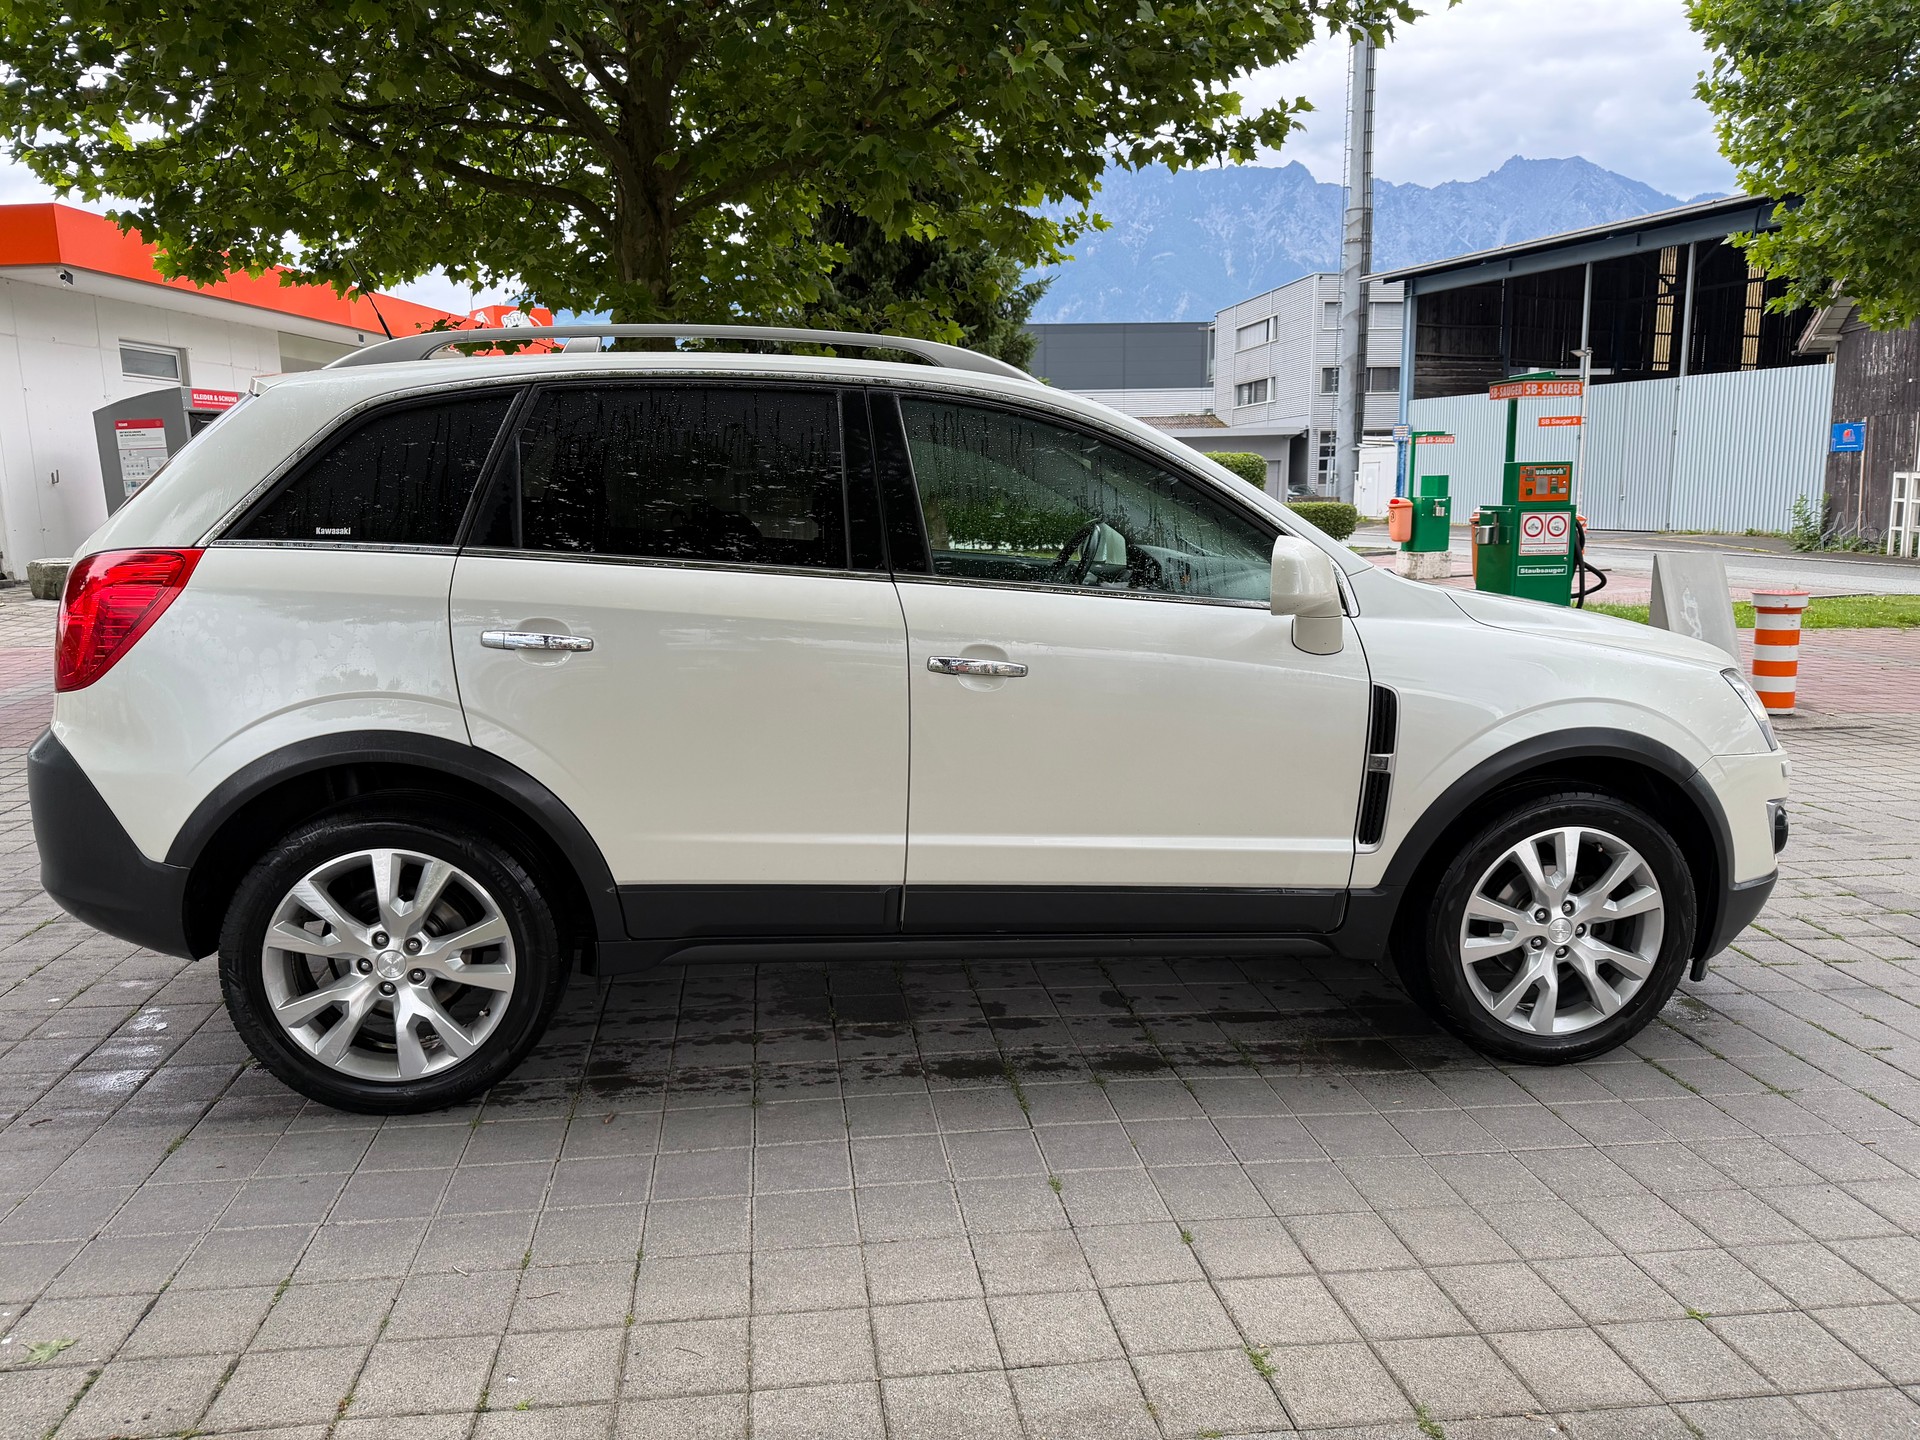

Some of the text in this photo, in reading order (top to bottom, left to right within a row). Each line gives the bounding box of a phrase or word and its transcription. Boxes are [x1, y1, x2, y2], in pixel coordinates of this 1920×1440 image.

[1490, 384, 1522, 399] SB-SAUGER
[1525, 383, 1580, 395] SB-SAUGER
[193, 393, 213, 401] KLEIDER
[1552, 418, 1572, 426] Sauger
[315, 526, 351, 535] Kawasaki
[1520, 567, 1565, 575] Staubsauger
